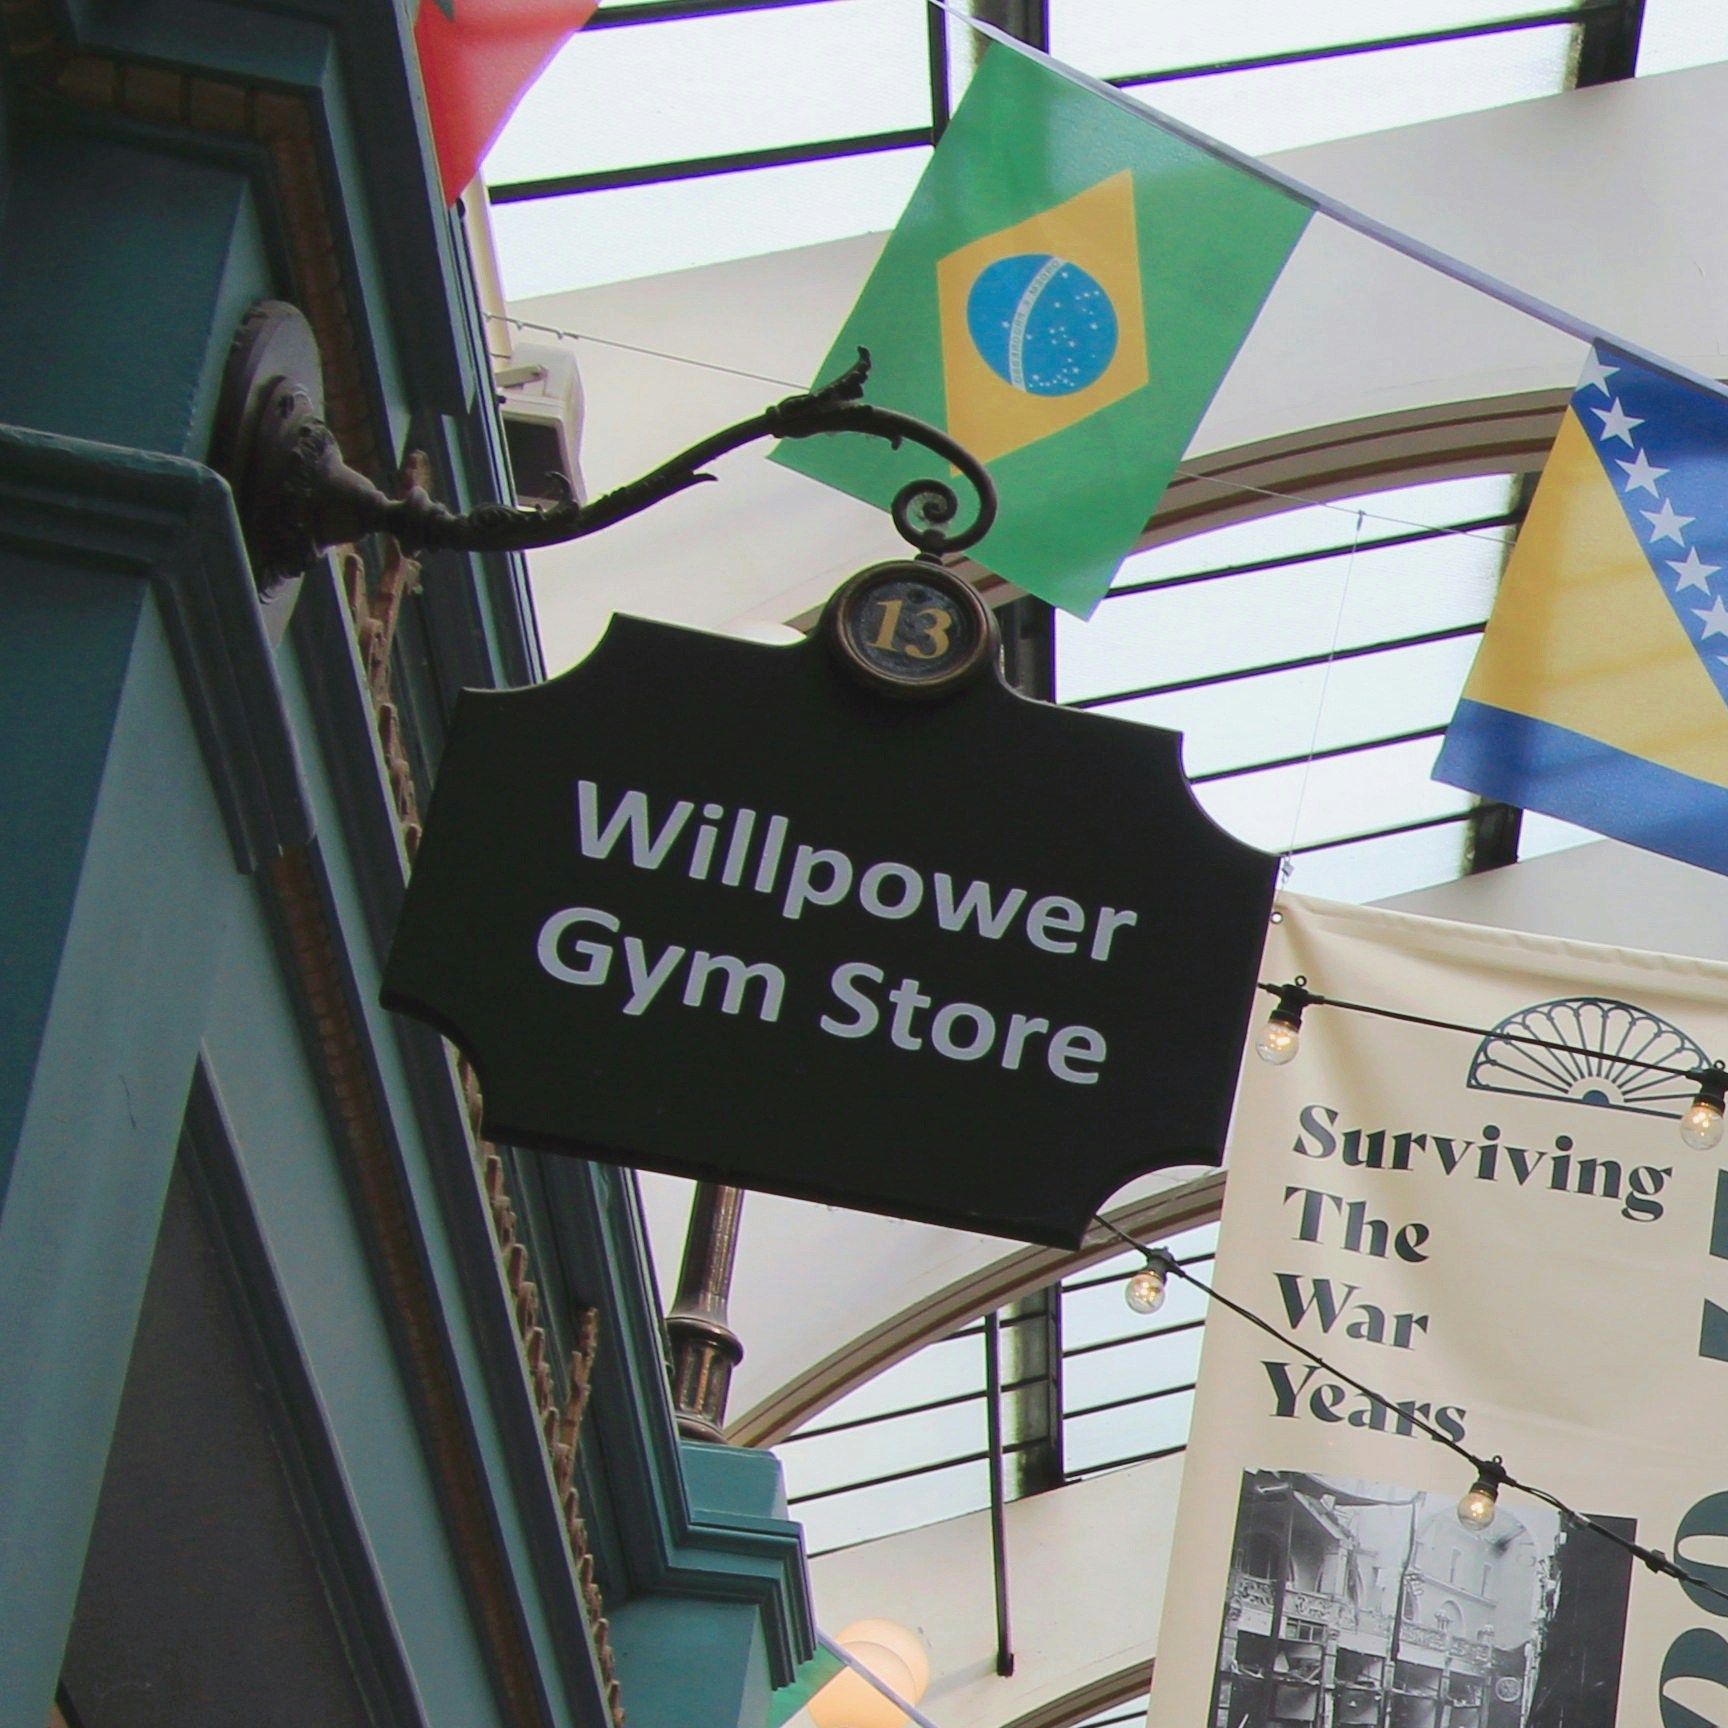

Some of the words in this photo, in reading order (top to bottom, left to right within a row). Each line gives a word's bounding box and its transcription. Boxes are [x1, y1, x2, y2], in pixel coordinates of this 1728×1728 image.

[869, 599, 955, 660] 13
[577, 780, 1138, 962] Willpower
[536, 906, 786, 1023] Gym
[820, 961, 1109, 1085] Store
[1293, 1105, 1673, 1222] Surviving
[1284, 1186, 1430, 1264] The
[1274, 1272, 1429, 1351] War
[1261, 1360, 1467, 1445] Years
